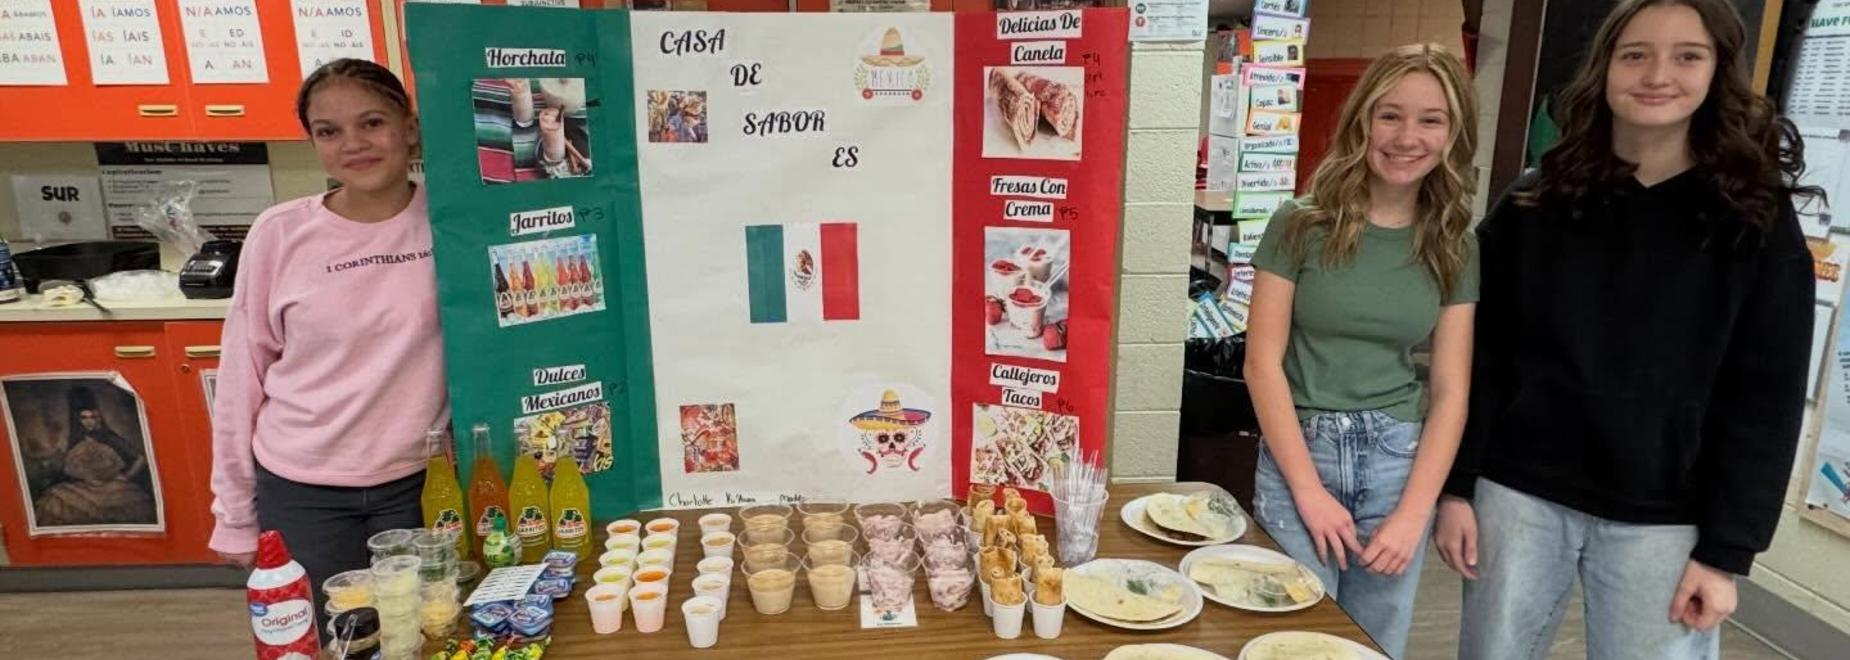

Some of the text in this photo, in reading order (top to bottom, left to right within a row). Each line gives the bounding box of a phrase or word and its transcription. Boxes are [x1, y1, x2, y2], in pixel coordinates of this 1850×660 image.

[215, 7, 252, 16] AMOS
[326, 7, 362, 17] AMOS
[1000, 12, 1080, 34] Delicias De
[1811, 18, 1838, 27] HAVE
[229, 29, 245, 38] ED
[660, 29, 726, 55] CASA
[487, 49, 565, 66] Horchata
[1014, 45, 1063, 61] Canela
[730, 63, 762, 86] DE
[743, 111, 825, 136] SABOR
[832, 146, 859, 168] ES
[41, 185, 80, 202] SUR
[992, 178, 1065, 194] Fresas Con
[1006, 201, 1050, 216] Crema
[512, 210, 572, 233] Jarritos
[326, 265, 332, 273] 1
[335, 253, 416, 271] CORINTHIANS
[535, 367, 585, 384] Dulces
[993, 365, 1056, 386] Callejeros
[525, 387, 600, 411] Mexicanos
[1003, 389, 1040, 406] Tacos
[262, 606, 308, 627] Original
